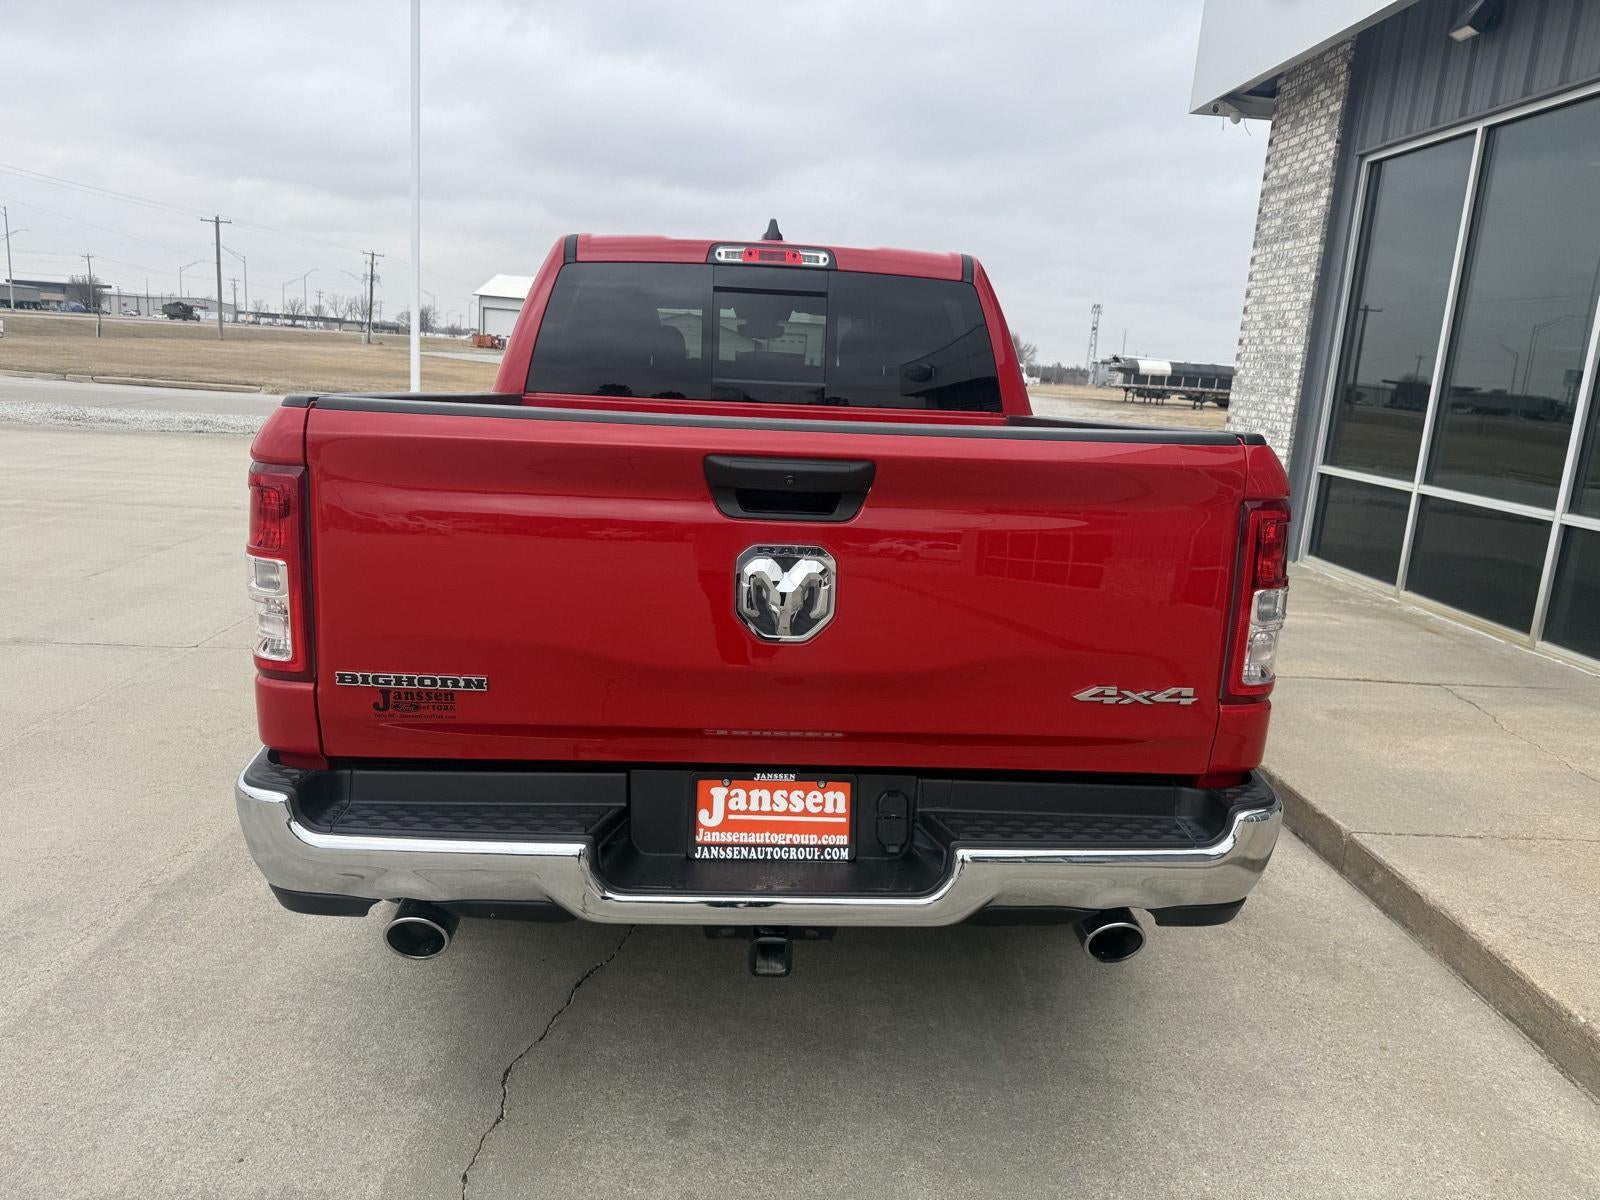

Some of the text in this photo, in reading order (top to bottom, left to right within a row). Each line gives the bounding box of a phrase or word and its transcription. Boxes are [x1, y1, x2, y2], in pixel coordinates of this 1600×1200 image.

[757, 546, 822, 555] RAM
[335, 671, 488, 691] BIGHORN
[373, 688, 455, 712] Janssen
[1072, 686, 1199, 705] 4x4
[753, 773, 796, 781] JANSSEN
[698, 786, 847, 827] Janssen
[695, 828, 848, 845] Janssenautogroup.com
